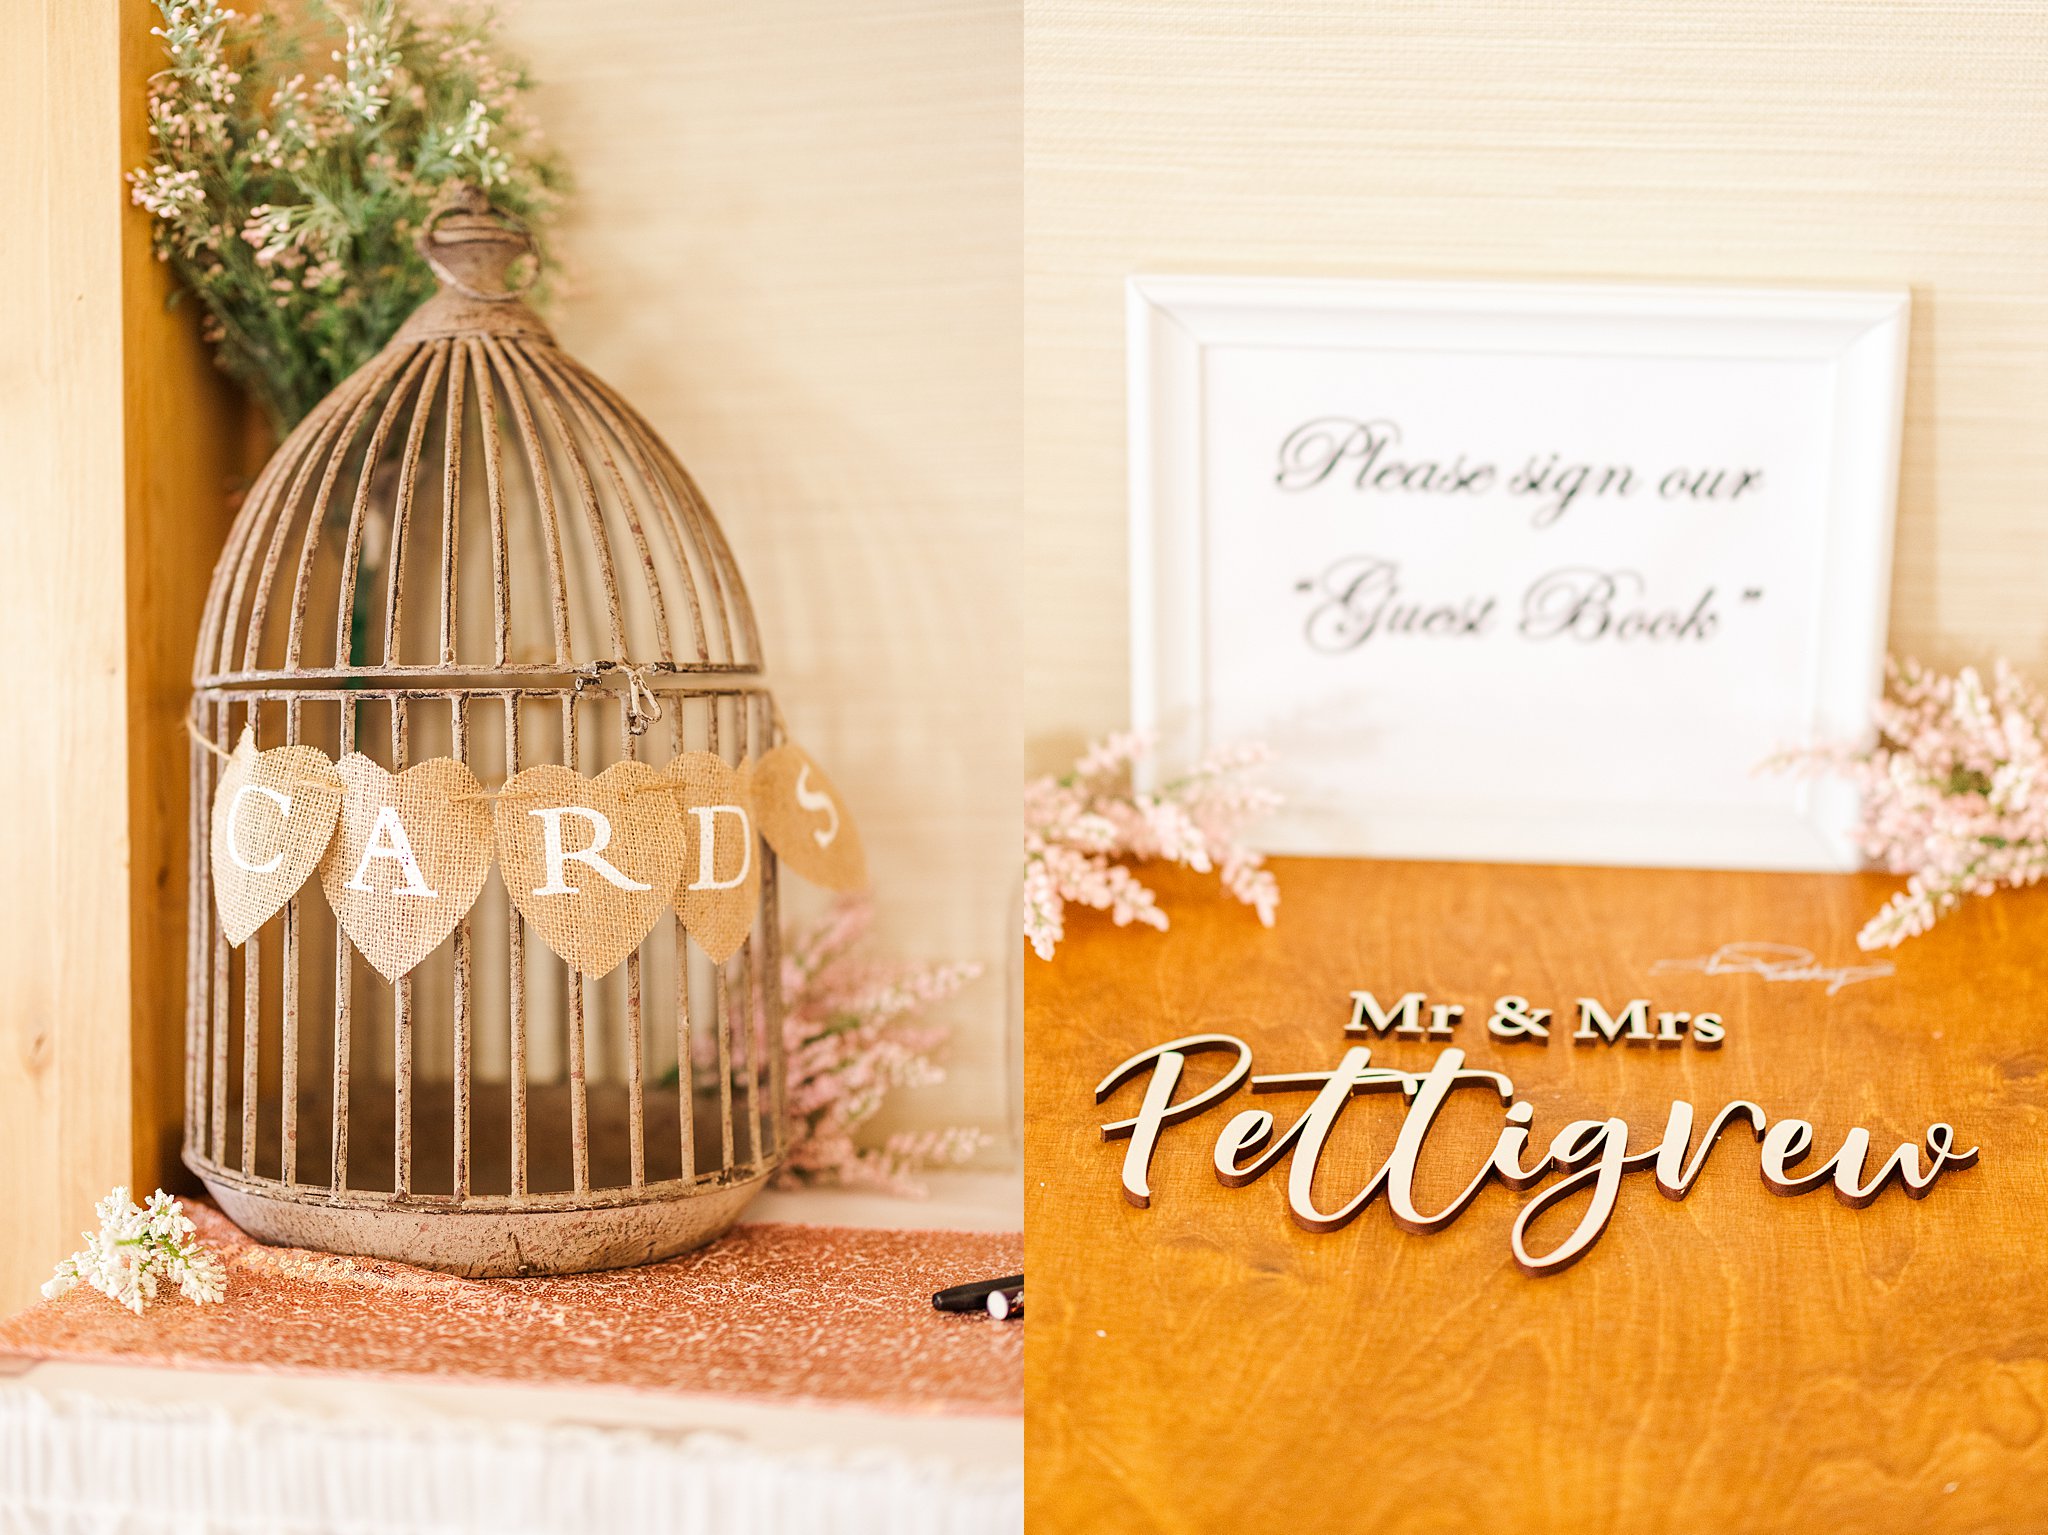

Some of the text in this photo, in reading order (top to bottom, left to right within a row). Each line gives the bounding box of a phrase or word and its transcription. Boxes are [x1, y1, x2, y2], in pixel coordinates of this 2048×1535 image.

[1275, 415, 1763, 530] Please sign our
[226, 764, 839, 899] CARDS
[1344, 990, 1726, 1050] Mr & Mrs
[1095, 1033, 1980, 1277] Pettigrew
